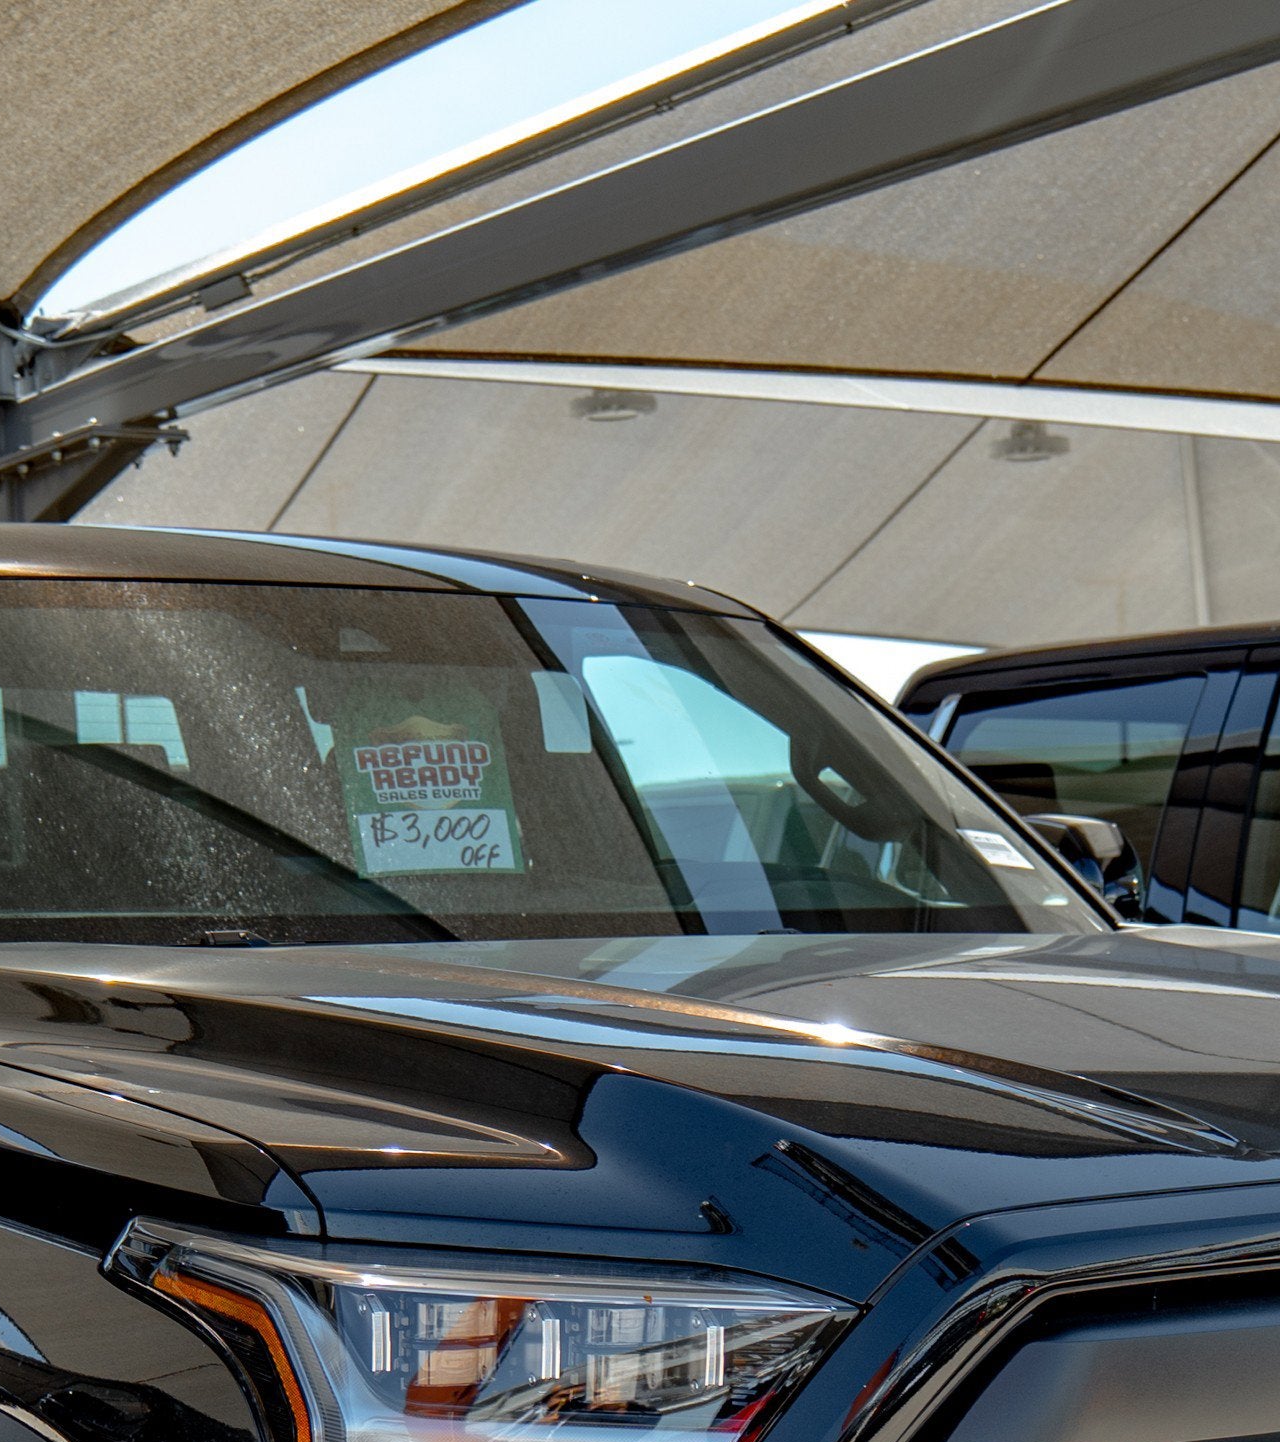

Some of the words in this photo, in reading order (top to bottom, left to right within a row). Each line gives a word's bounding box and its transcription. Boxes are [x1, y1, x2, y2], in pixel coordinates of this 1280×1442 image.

[357, 744, 489, 770] REFUND
[373, 765, 481, 790] READY
[378, 789, 428, 801] SALES
[432, 788, 480, 800] EVENT
[371, 812, 490, 848] $3,000
[461, 844, 500, 867] OFF
